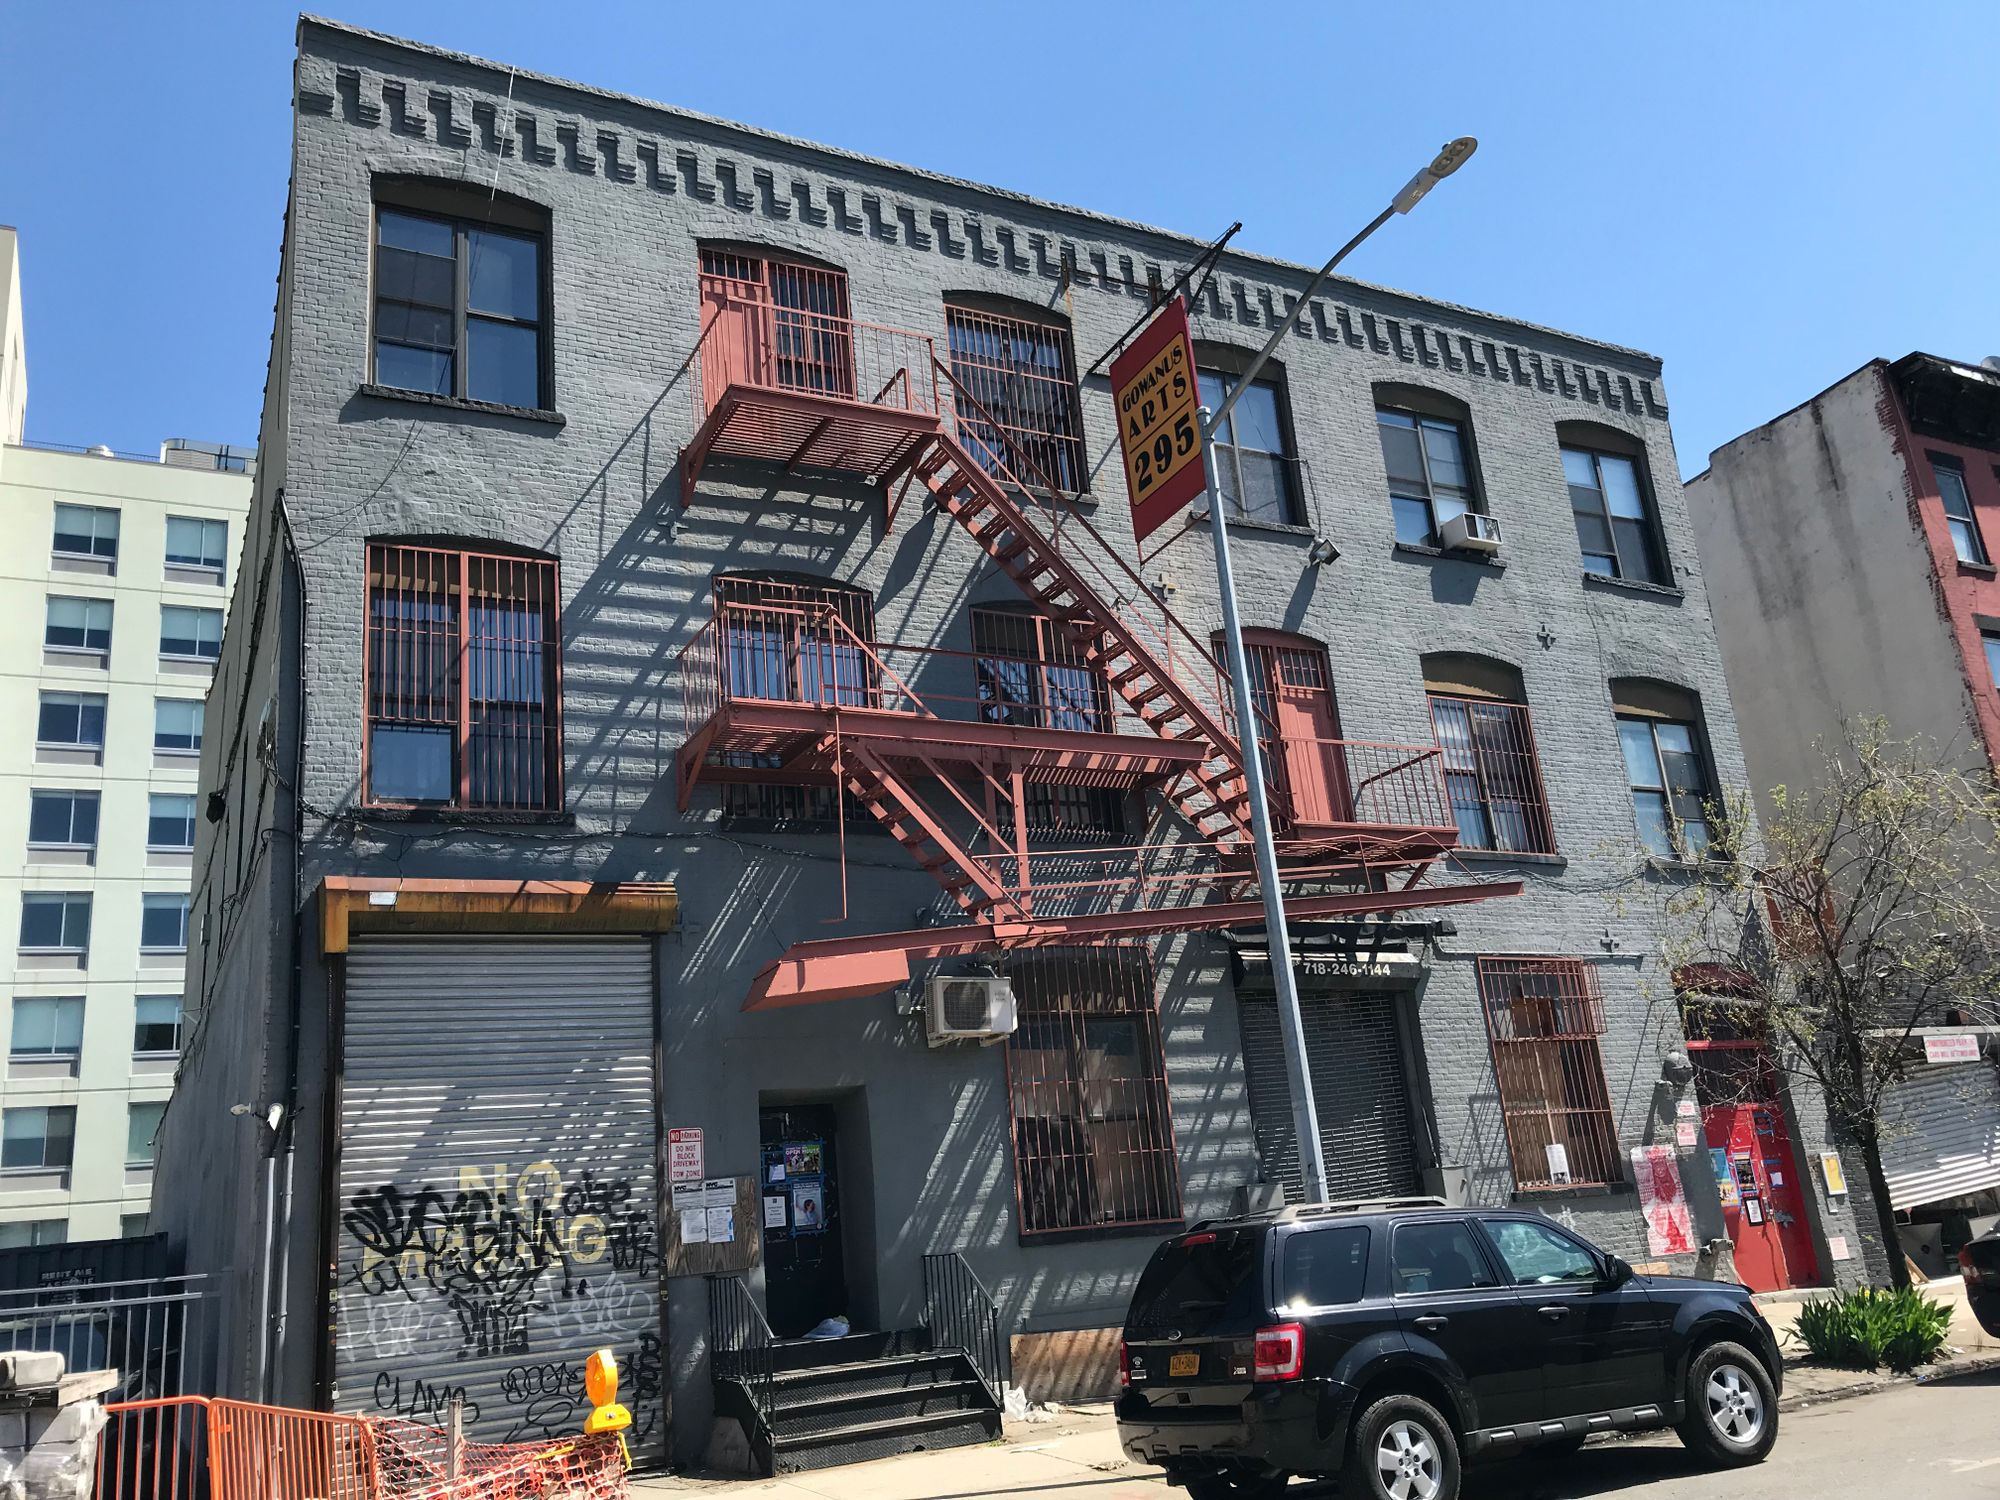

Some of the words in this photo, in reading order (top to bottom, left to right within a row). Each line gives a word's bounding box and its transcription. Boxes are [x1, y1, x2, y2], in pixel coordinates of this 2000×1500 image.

[1122, 344, 1183, 413] GOWANUS
[1128, 371, 1187, 444] ARTS
[1134, 411, 1195, 494] 295
[1303, 962, 1391, 976] 718-246-1144
[670, 1132, 680, 1140] NO
[681, 1131, 700, 1139] PARKING
[673, 1160, 699, 1168] DRIVEWAY
[686, 1170, 700, 1178] ZONE
